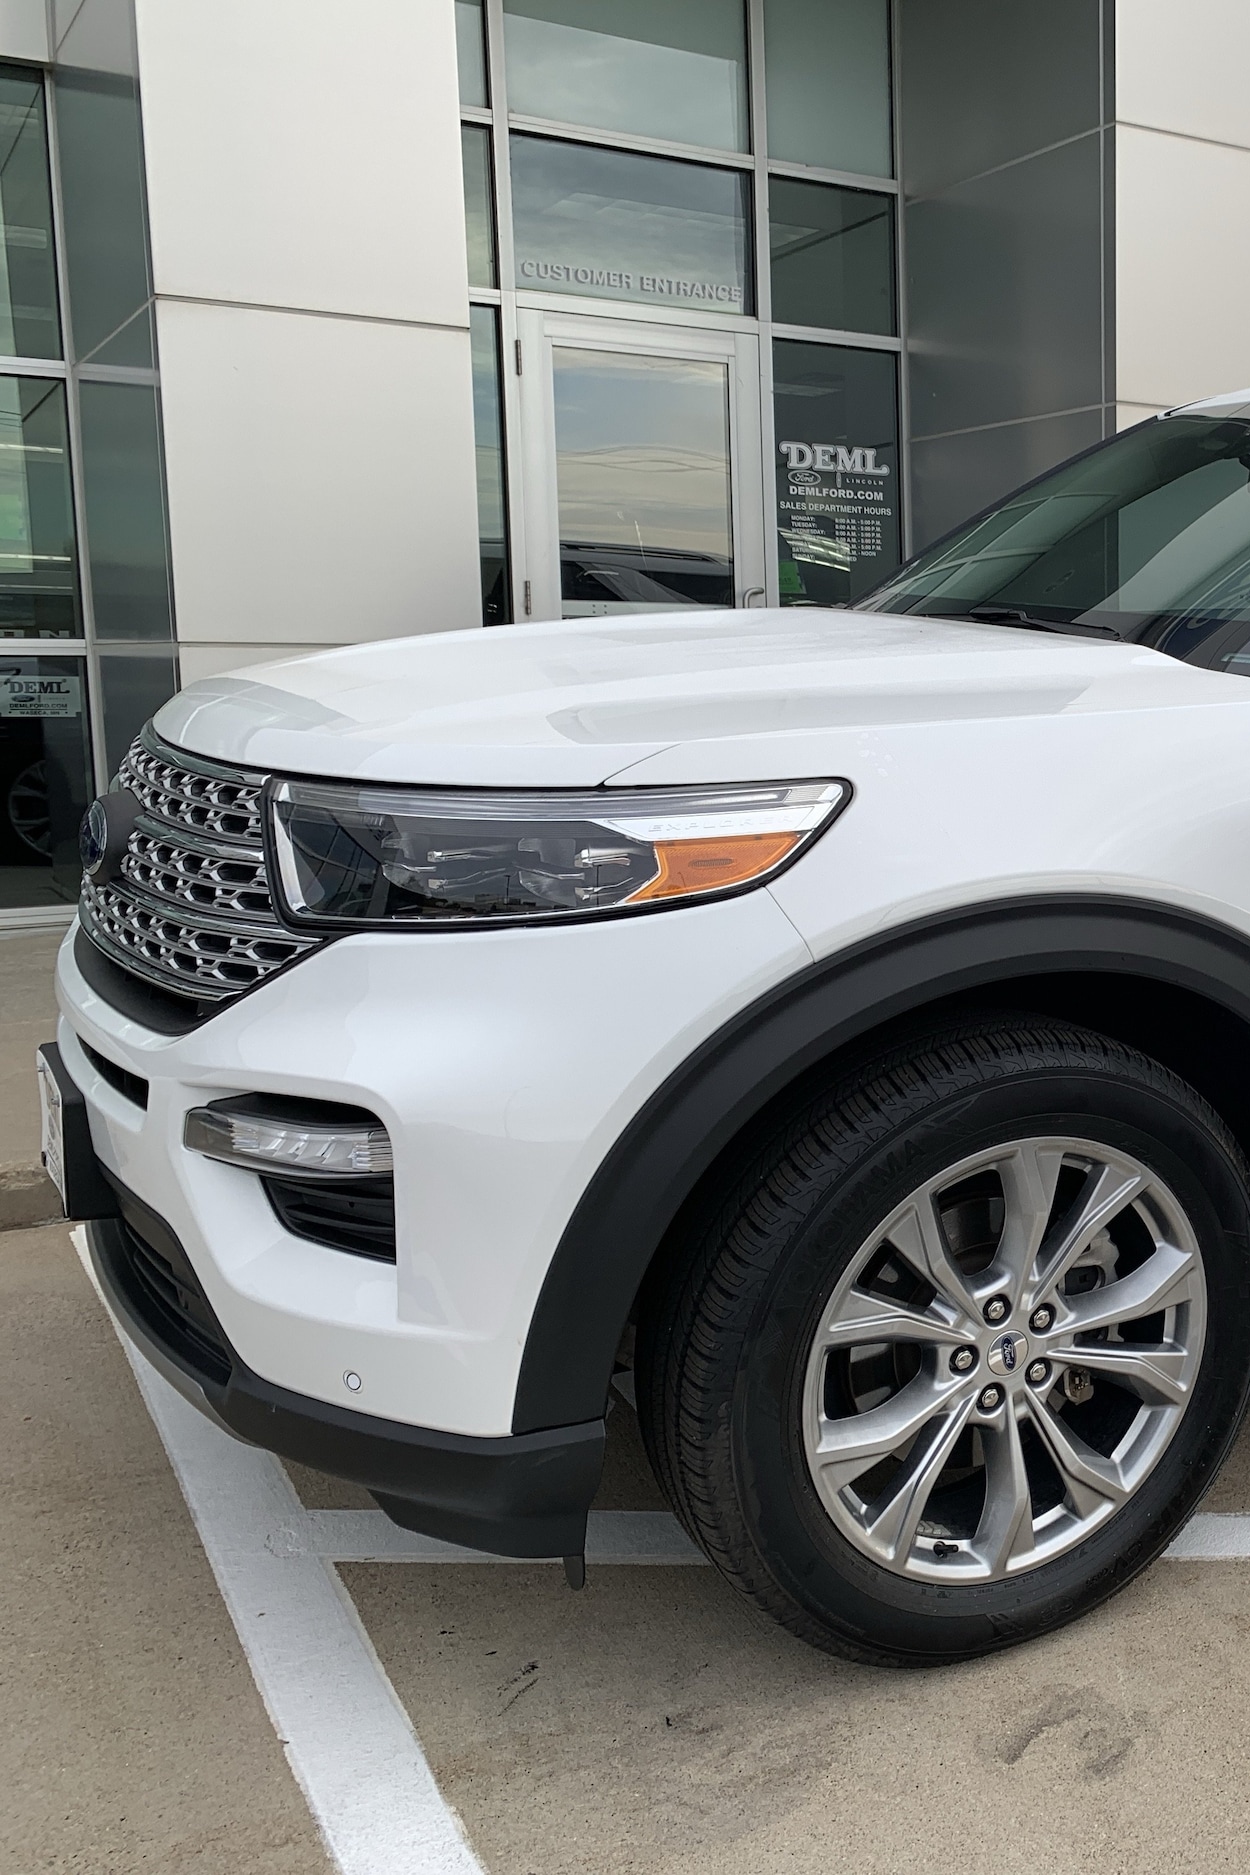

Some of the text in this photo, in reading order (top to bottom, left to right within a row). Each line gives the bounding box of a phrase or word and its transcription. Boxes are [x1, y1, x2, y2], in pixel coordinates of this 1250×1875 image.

[520, 259, 742, 303] CUSTOMER ENTRANCE
[779, 441, 890, 476] DEML
[846, 478, 884, 486] LINCOLN
[789, 486, 884, 501] DEMLFORD.COM
[780, 501, 892, 516] SALES DEPARTMENT HOURS
[4, 679, 70, 694] DEML
